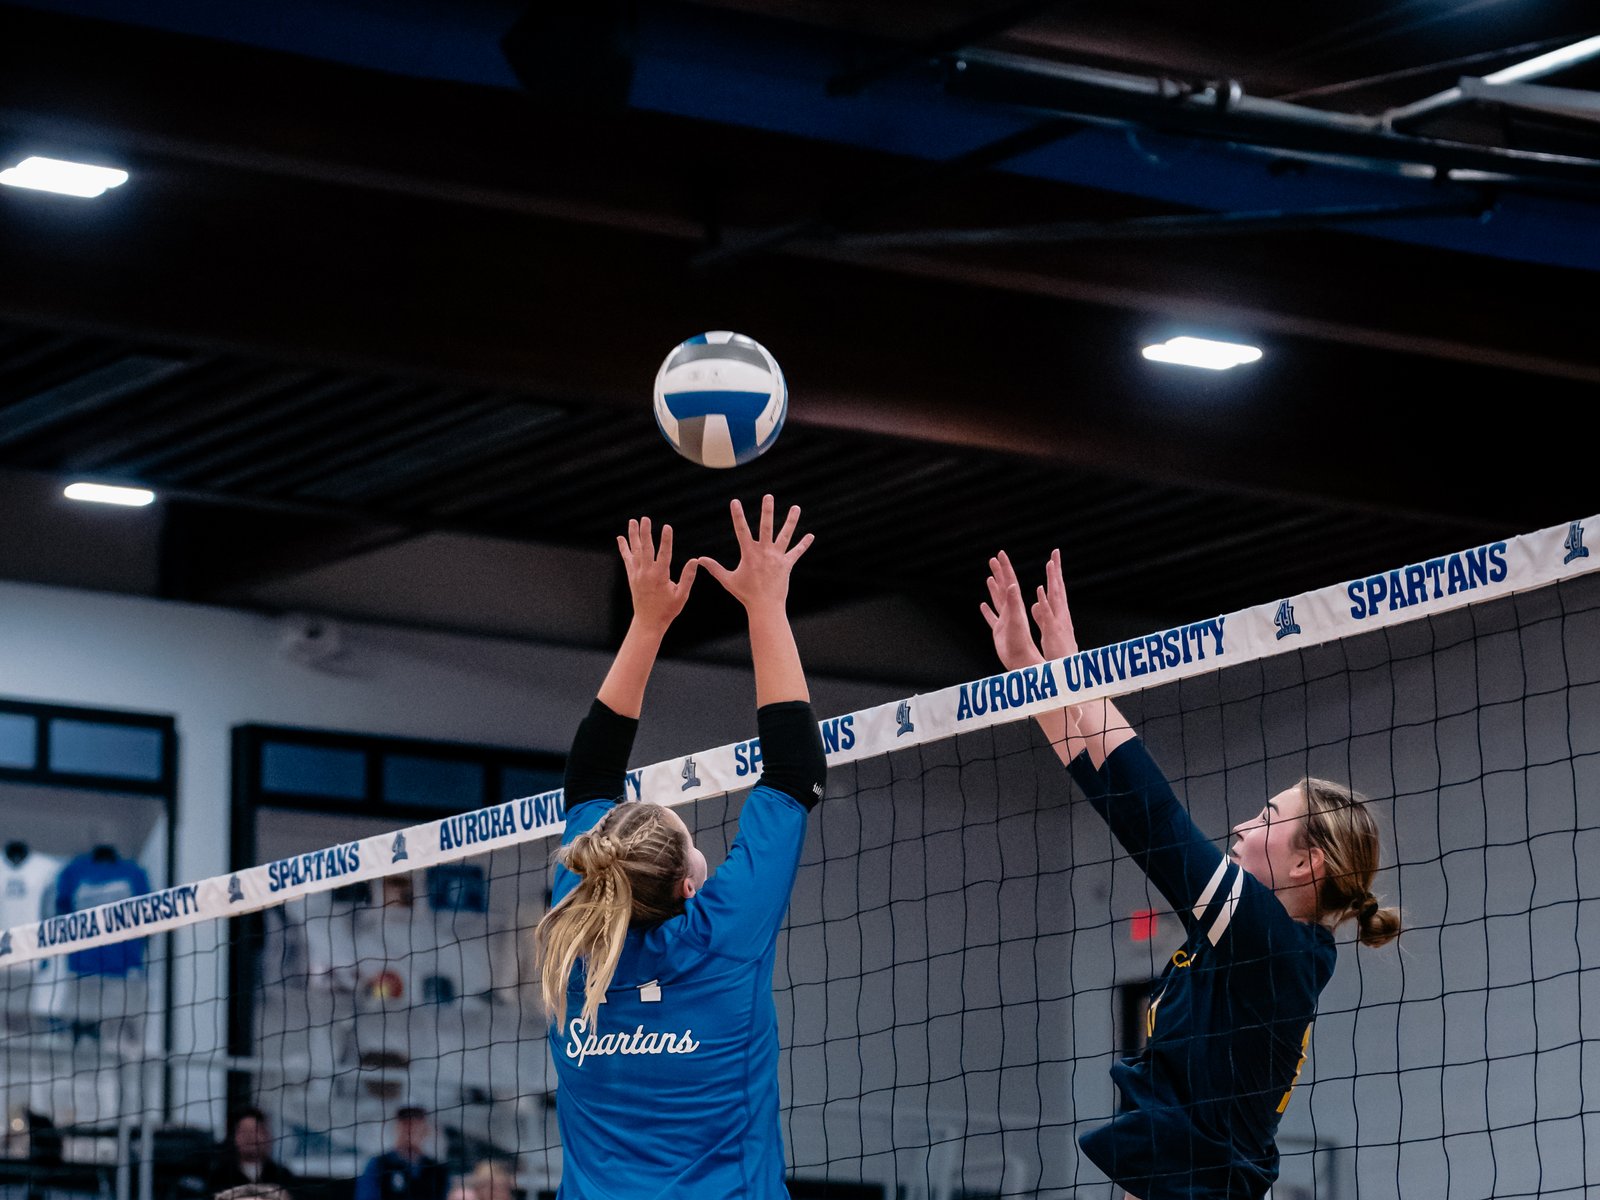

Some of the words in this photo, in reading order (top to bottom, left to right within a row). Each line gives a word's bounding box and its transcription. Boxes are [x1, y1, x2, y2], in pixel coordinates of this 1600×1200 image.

[1347, 541, 1508, 620] SPARTANS
[957, 662, 1058, 721] AURORA
[1063, 616, 1226, 692] UNIVERSITY
[439, 803, 517, 851] AURORA
[268, 842, 360, 892] SPARTANS
[37, 911, 100, 948] AURORA
[103, 885, 199, 933] UNIVERSITY
[566, 1017, 700, 1067] Spartans
